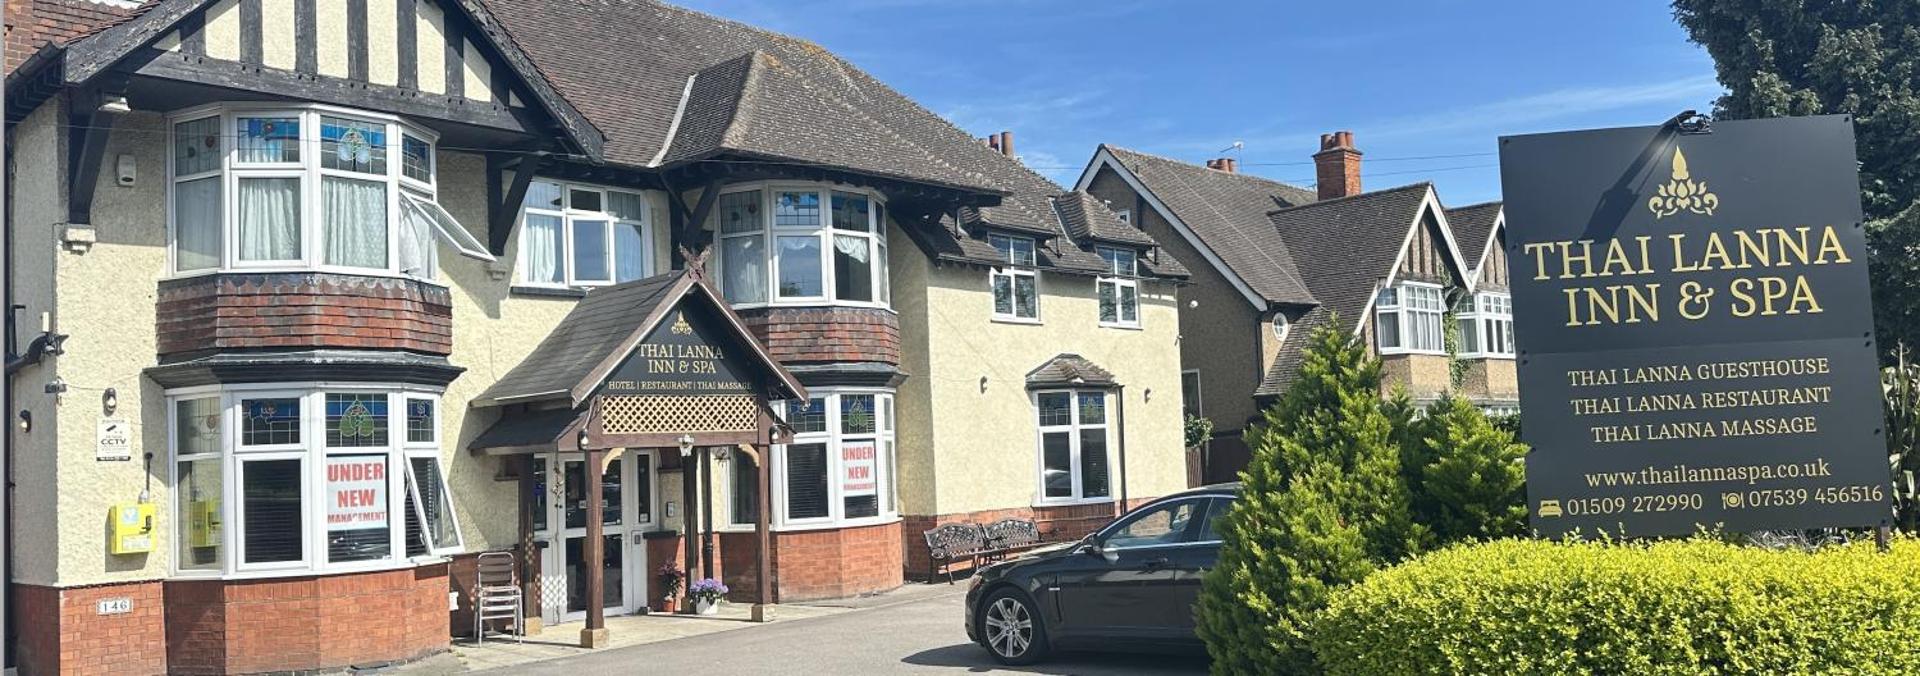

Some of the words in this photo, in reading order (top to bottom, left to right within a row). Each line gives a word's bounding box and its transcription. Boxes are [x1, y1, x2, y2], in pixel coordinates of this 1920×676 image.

[1525, 236, 1655, 281] THAI
[1668, 226, 1851, 272] LANNA
[1563, 283, 1661, 326] INN
[1678, 281, 1714, 320] &
[1730, 275, 1823, 317] SPA
[638, 344, 674, 358] THAI
[677, 345, 724, 359] LANNA
[648, 360, 675, 373] INN
[679, 361, 689, 374] &
[692, 360, 717, 374] SPA
[1568, 370, 1618, 387] THAI
[1623, 365, 1693, 385] LANNA
[1697, 358, 1830, 380] GUESTHOUSE
[608, 381, 636, 390] HOTEL
[641, 381, 693, 390] RESTAURANT
[697, 381, 717, 390] THAI
[1570, 398, 1621, 416] THAI
[1627, 394, 1696, 412] LANNA
[1702, 386, 1831, 409] RESTAURANT
[1591, 426, 1640, 443] THAI
[1646, 422, 1717, 440] LANNA
[1721, 416, 1817, 437] MASSAGE
[842, 447, 874, 461] UNDER
[328, 463, 384, 482] UNDER
[848, 466, 869, 480] NEW
[1585, 458, 1832, 488] www.thailannaspa.co.uk
[338, 489, 376, 508] NEW
[1567, 497, 1626, 515] 01509
[1632, 494, 1703, 513] 272990
[1750, 489, 1807, 507] 07539
[1815, 485, 1883, 504] 456516
[104, 600, 128, 612] 146
